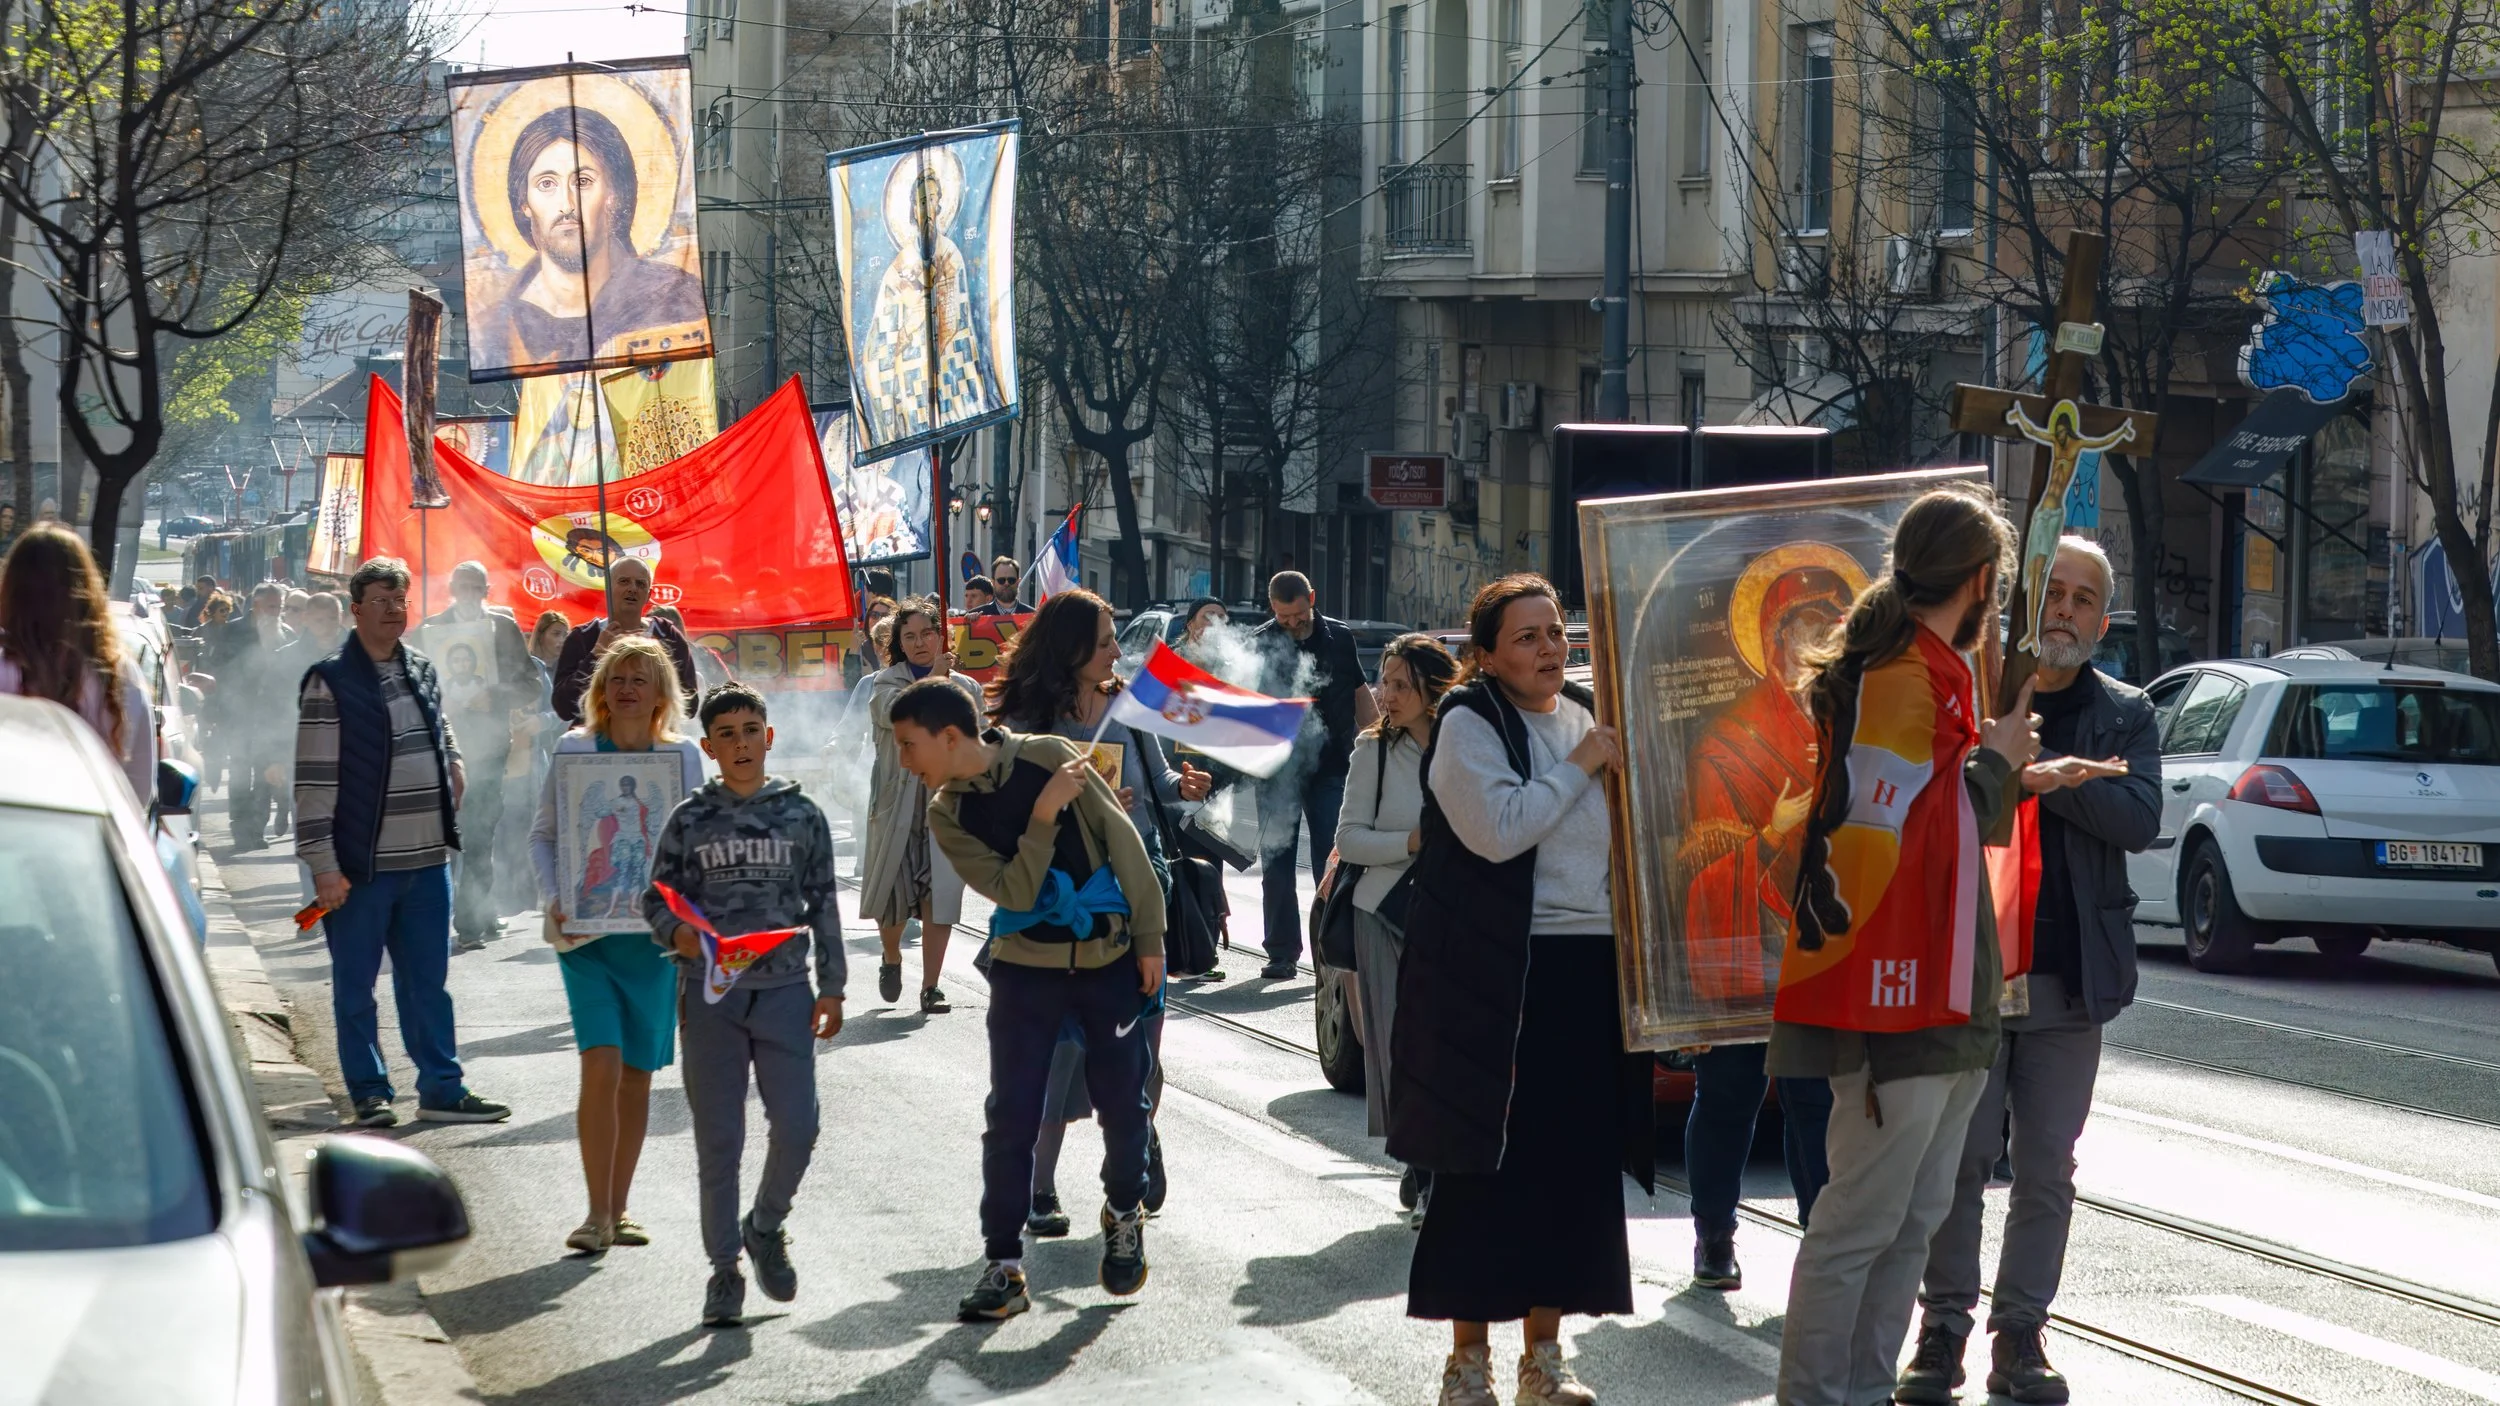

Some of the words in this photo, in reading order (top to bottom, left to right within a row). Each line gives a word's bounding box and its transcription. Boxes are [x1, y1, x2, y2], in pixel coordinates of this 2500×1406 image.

[2229, 432, 2258, 450] THE
[2251, 435, 2306, 453] PERFUME
[694, 838, 795, 869] TAPOUT
[2389, 844, 2408, 861] BG
